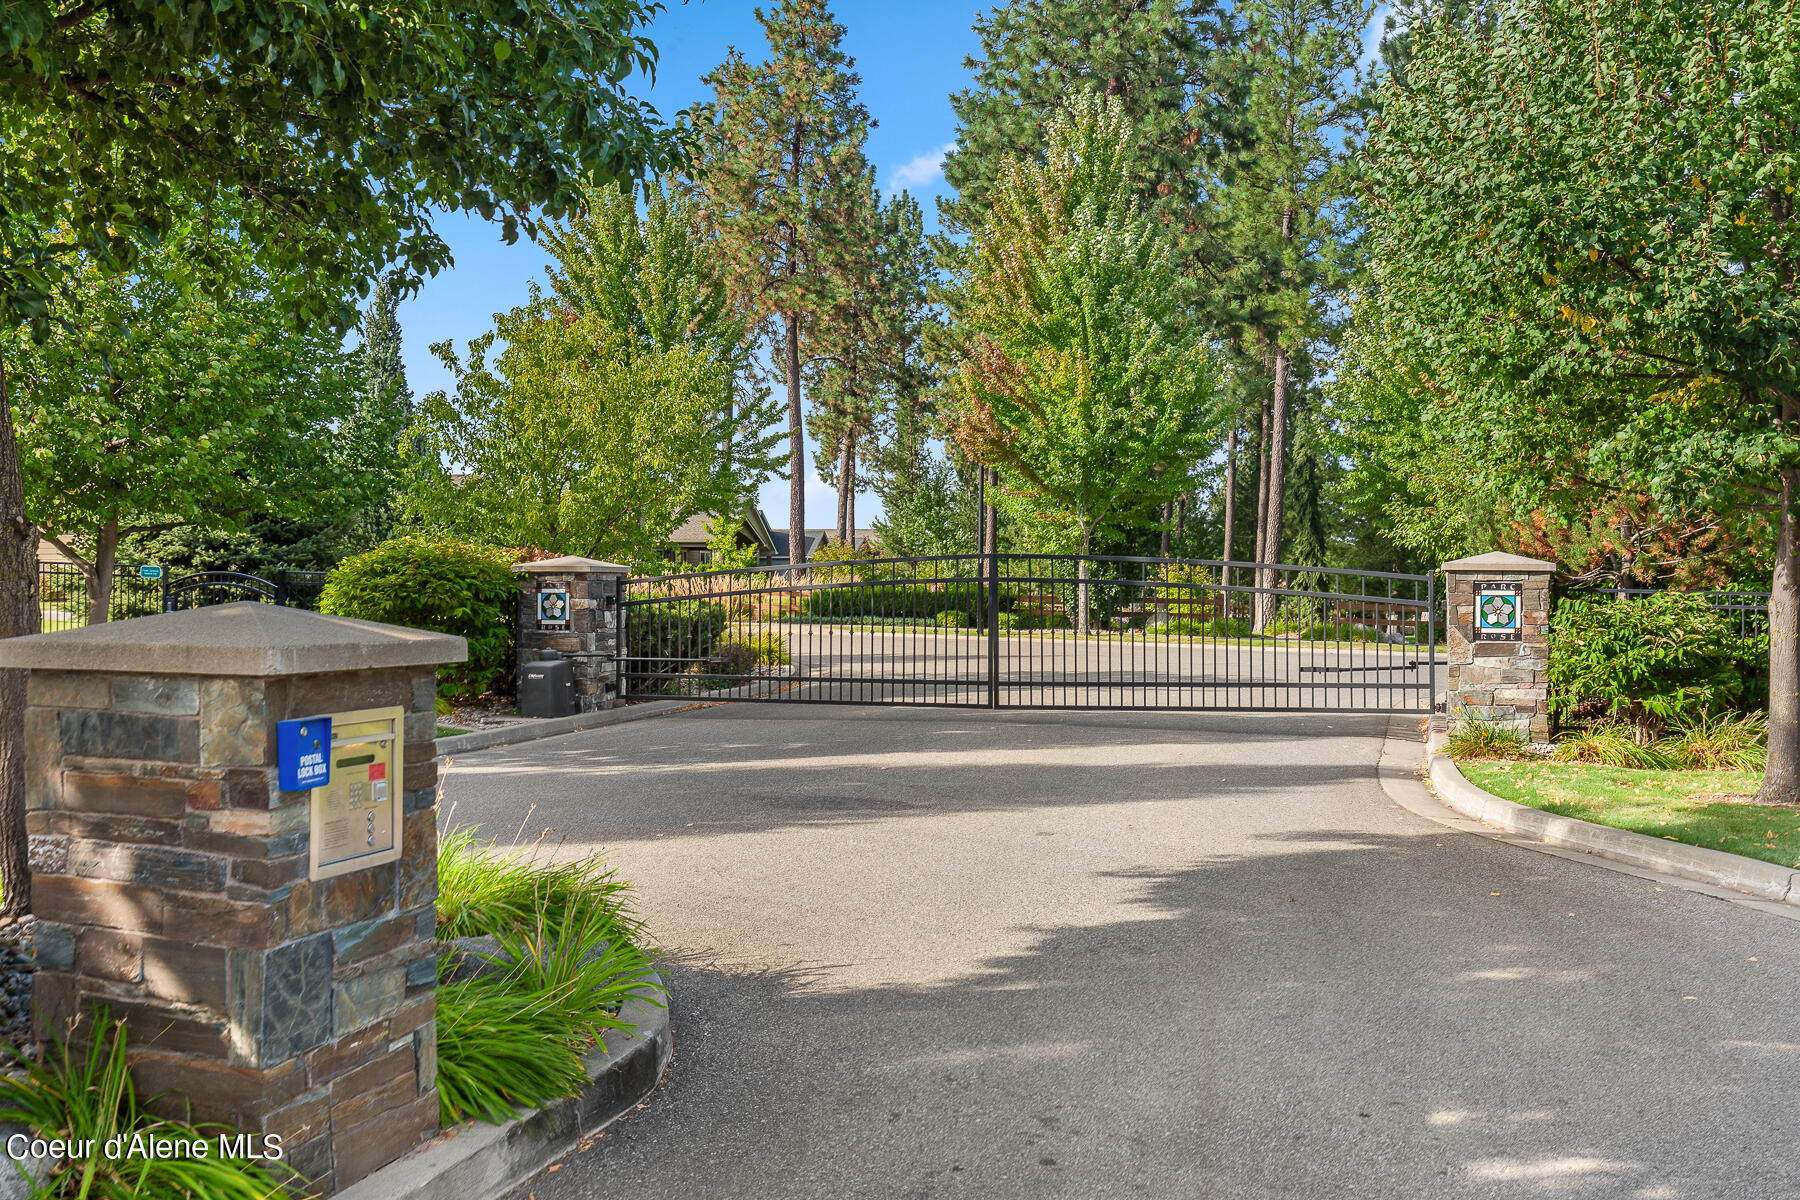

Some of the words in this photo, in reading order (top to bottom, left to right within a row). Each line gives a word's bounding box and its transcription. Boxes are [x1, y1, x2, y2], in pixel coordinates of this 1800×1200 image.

[300, 753, 323, 766] POSTAL
[297, 766, 313, 779] LOCK
[314, 763, 326, 775] BOX
